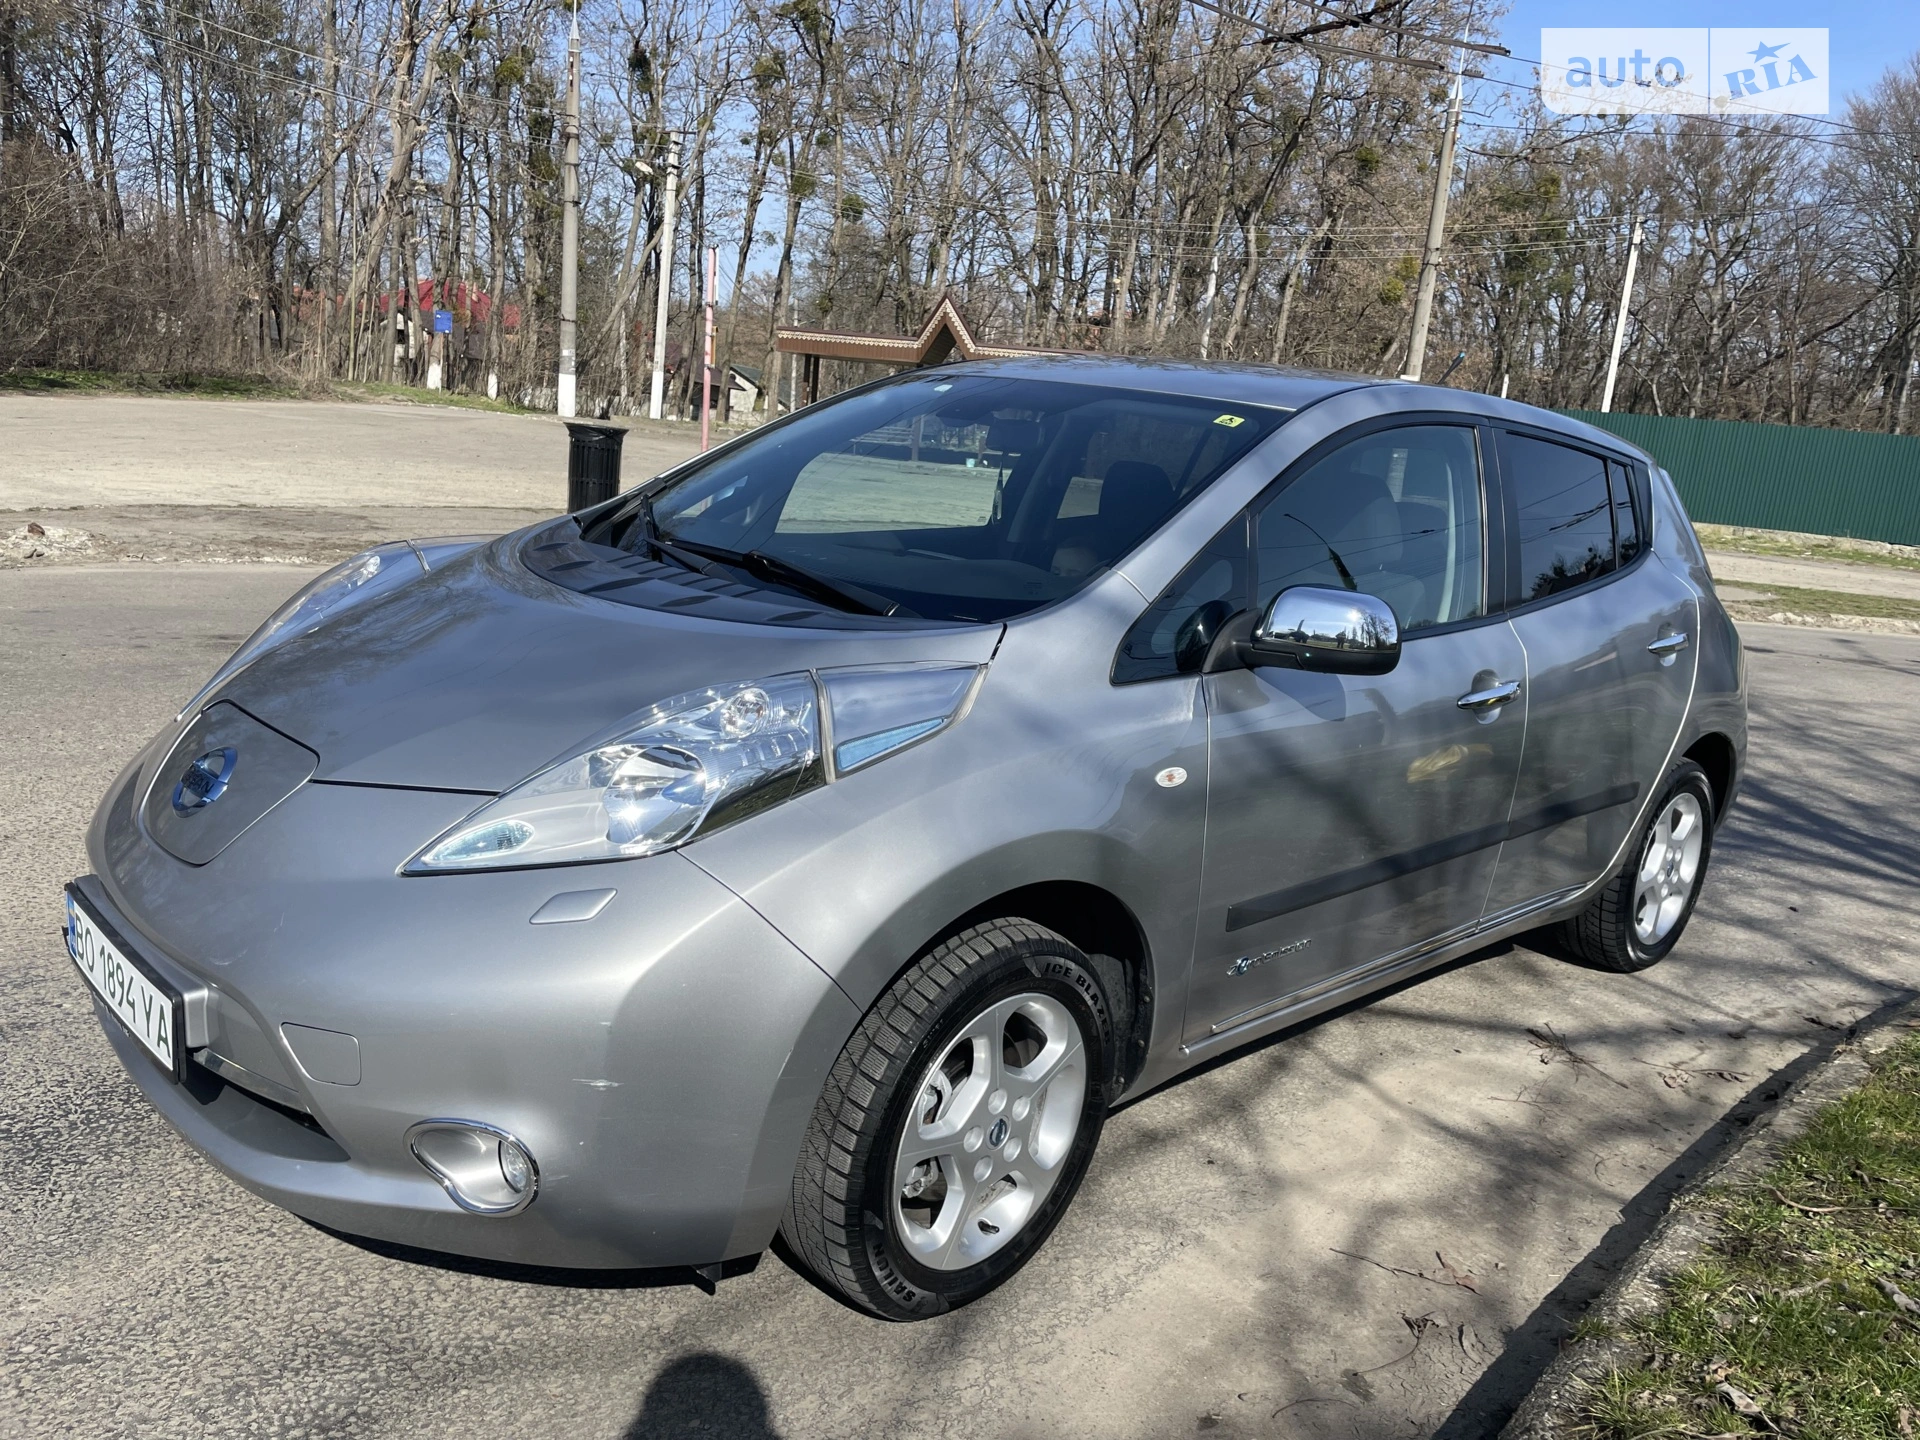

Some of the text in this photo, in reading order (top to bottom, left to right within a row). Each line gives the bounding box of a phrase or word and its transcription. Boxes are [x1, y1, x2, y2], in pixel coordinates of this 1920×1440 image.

[75, 910, 95, 973] BO
[99, 944, 136, 1025] 1894
[141, 985, 171, 1059] YA
[1043, 962, 1110, 1045] ICE BLAZER
[872, 1242, 917, 1303] SAILUN
